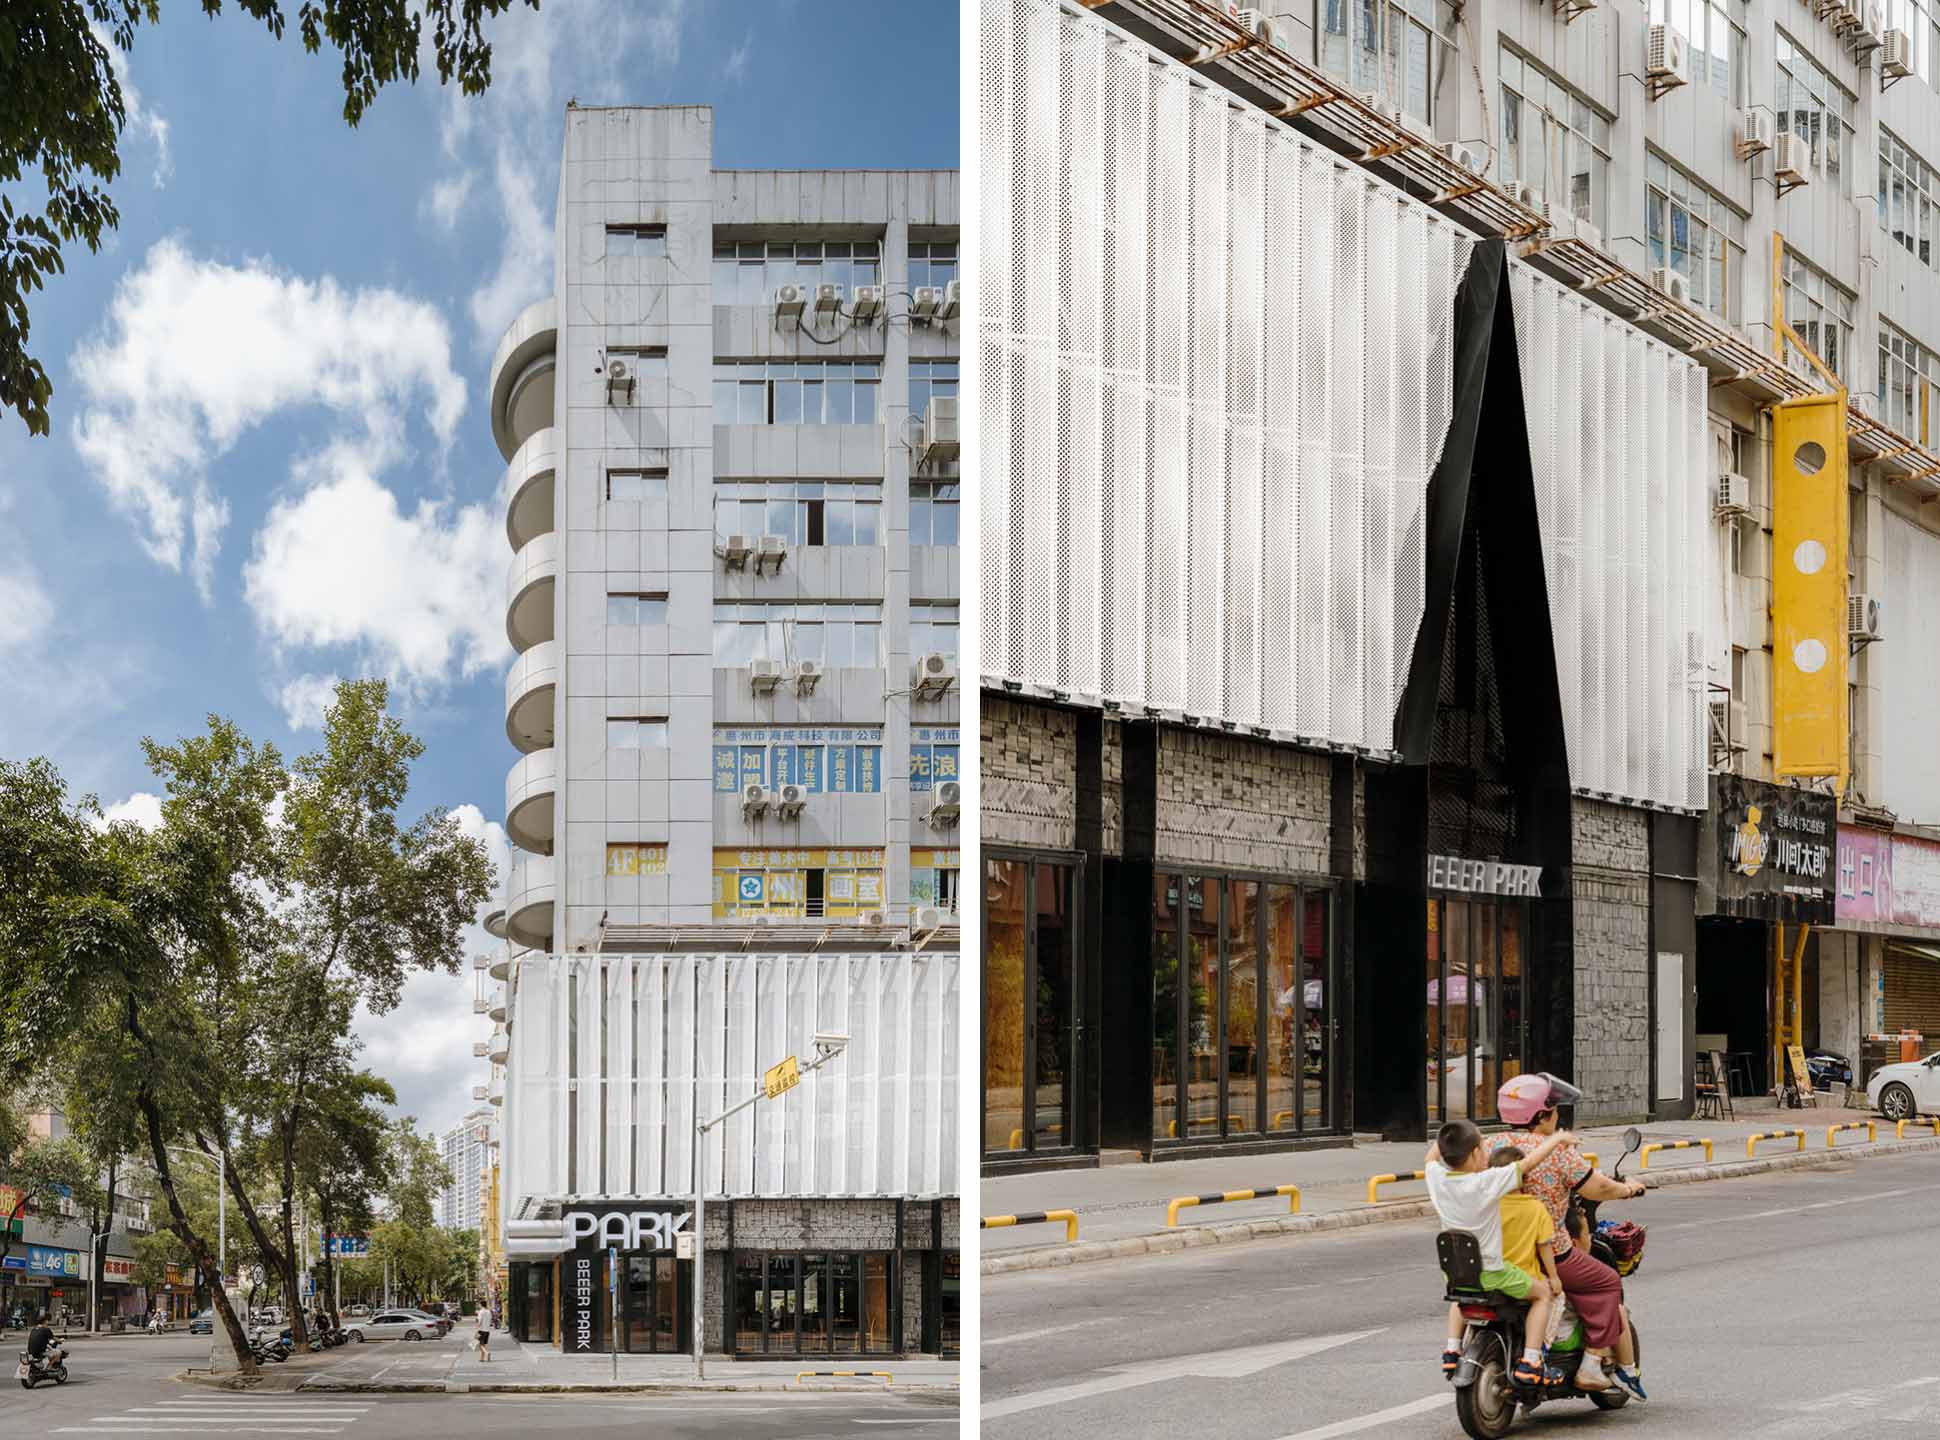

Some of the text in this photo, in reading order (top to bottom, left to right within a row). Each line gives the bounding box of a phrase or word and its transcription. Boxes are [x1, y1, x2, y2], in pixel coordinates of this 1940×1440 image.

[1428, 854, 1543, 897] EEER PARK
[568, 1212, 692, 1249] PARK
[577, 1259, 591, 1349] BEEER PARK
